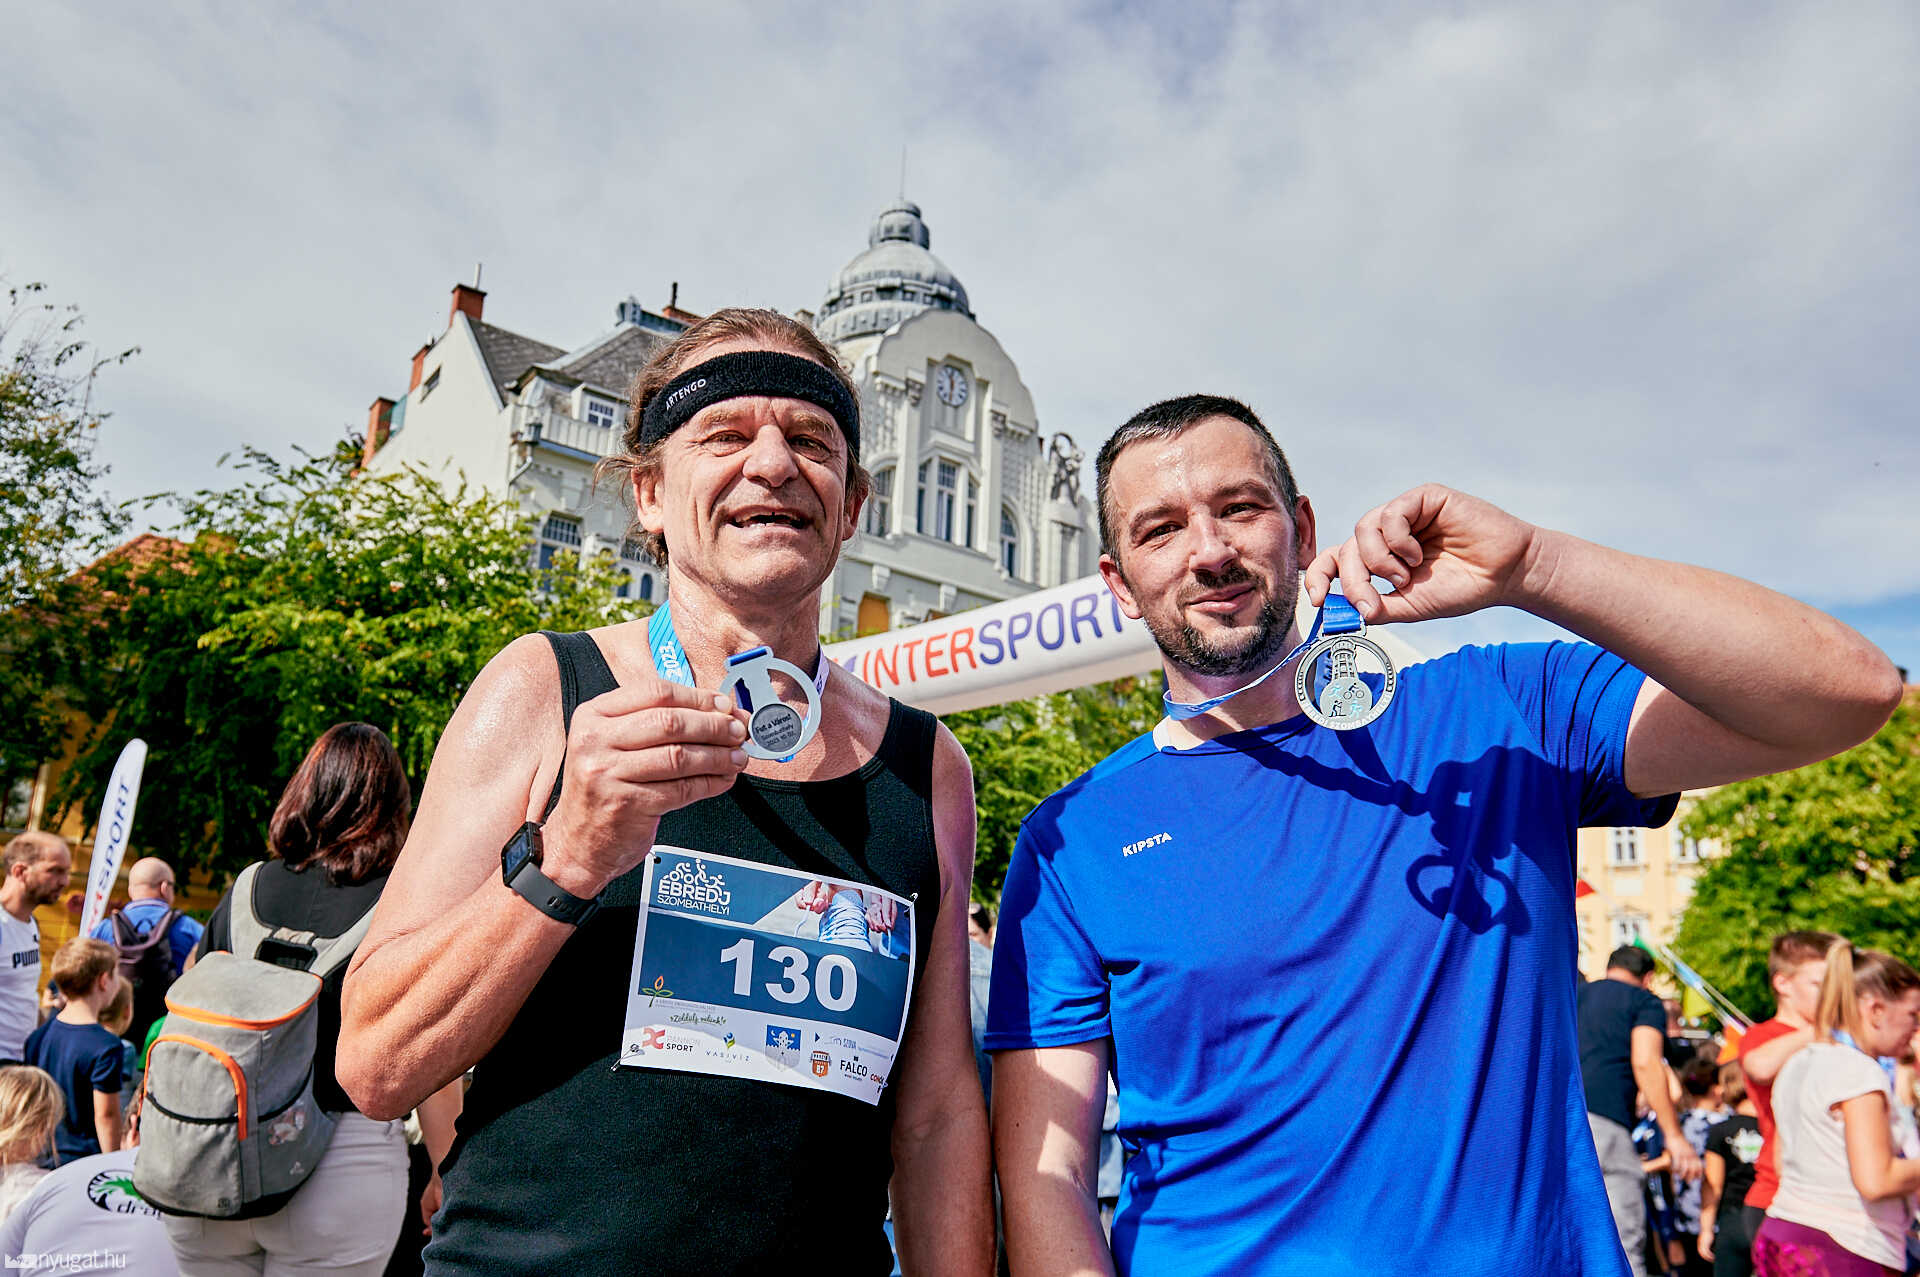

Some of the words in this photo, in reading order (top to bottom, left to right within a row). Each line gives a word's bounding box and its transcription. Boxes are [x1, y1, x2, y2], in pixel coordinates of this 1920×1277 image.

[665, 379, 706, 411] ARTENGO
[862, 589, 1123, 690] INTERSPORT
[1122, 832, 1173, 857] KIPSTA
[657, 894, 730, 916] SZOMBATHELYI
[720, 938, 858, 1012] 130
[666, 1043, 693, 1053] SPORT
[840, 1059, 868, 1077] FALCO
